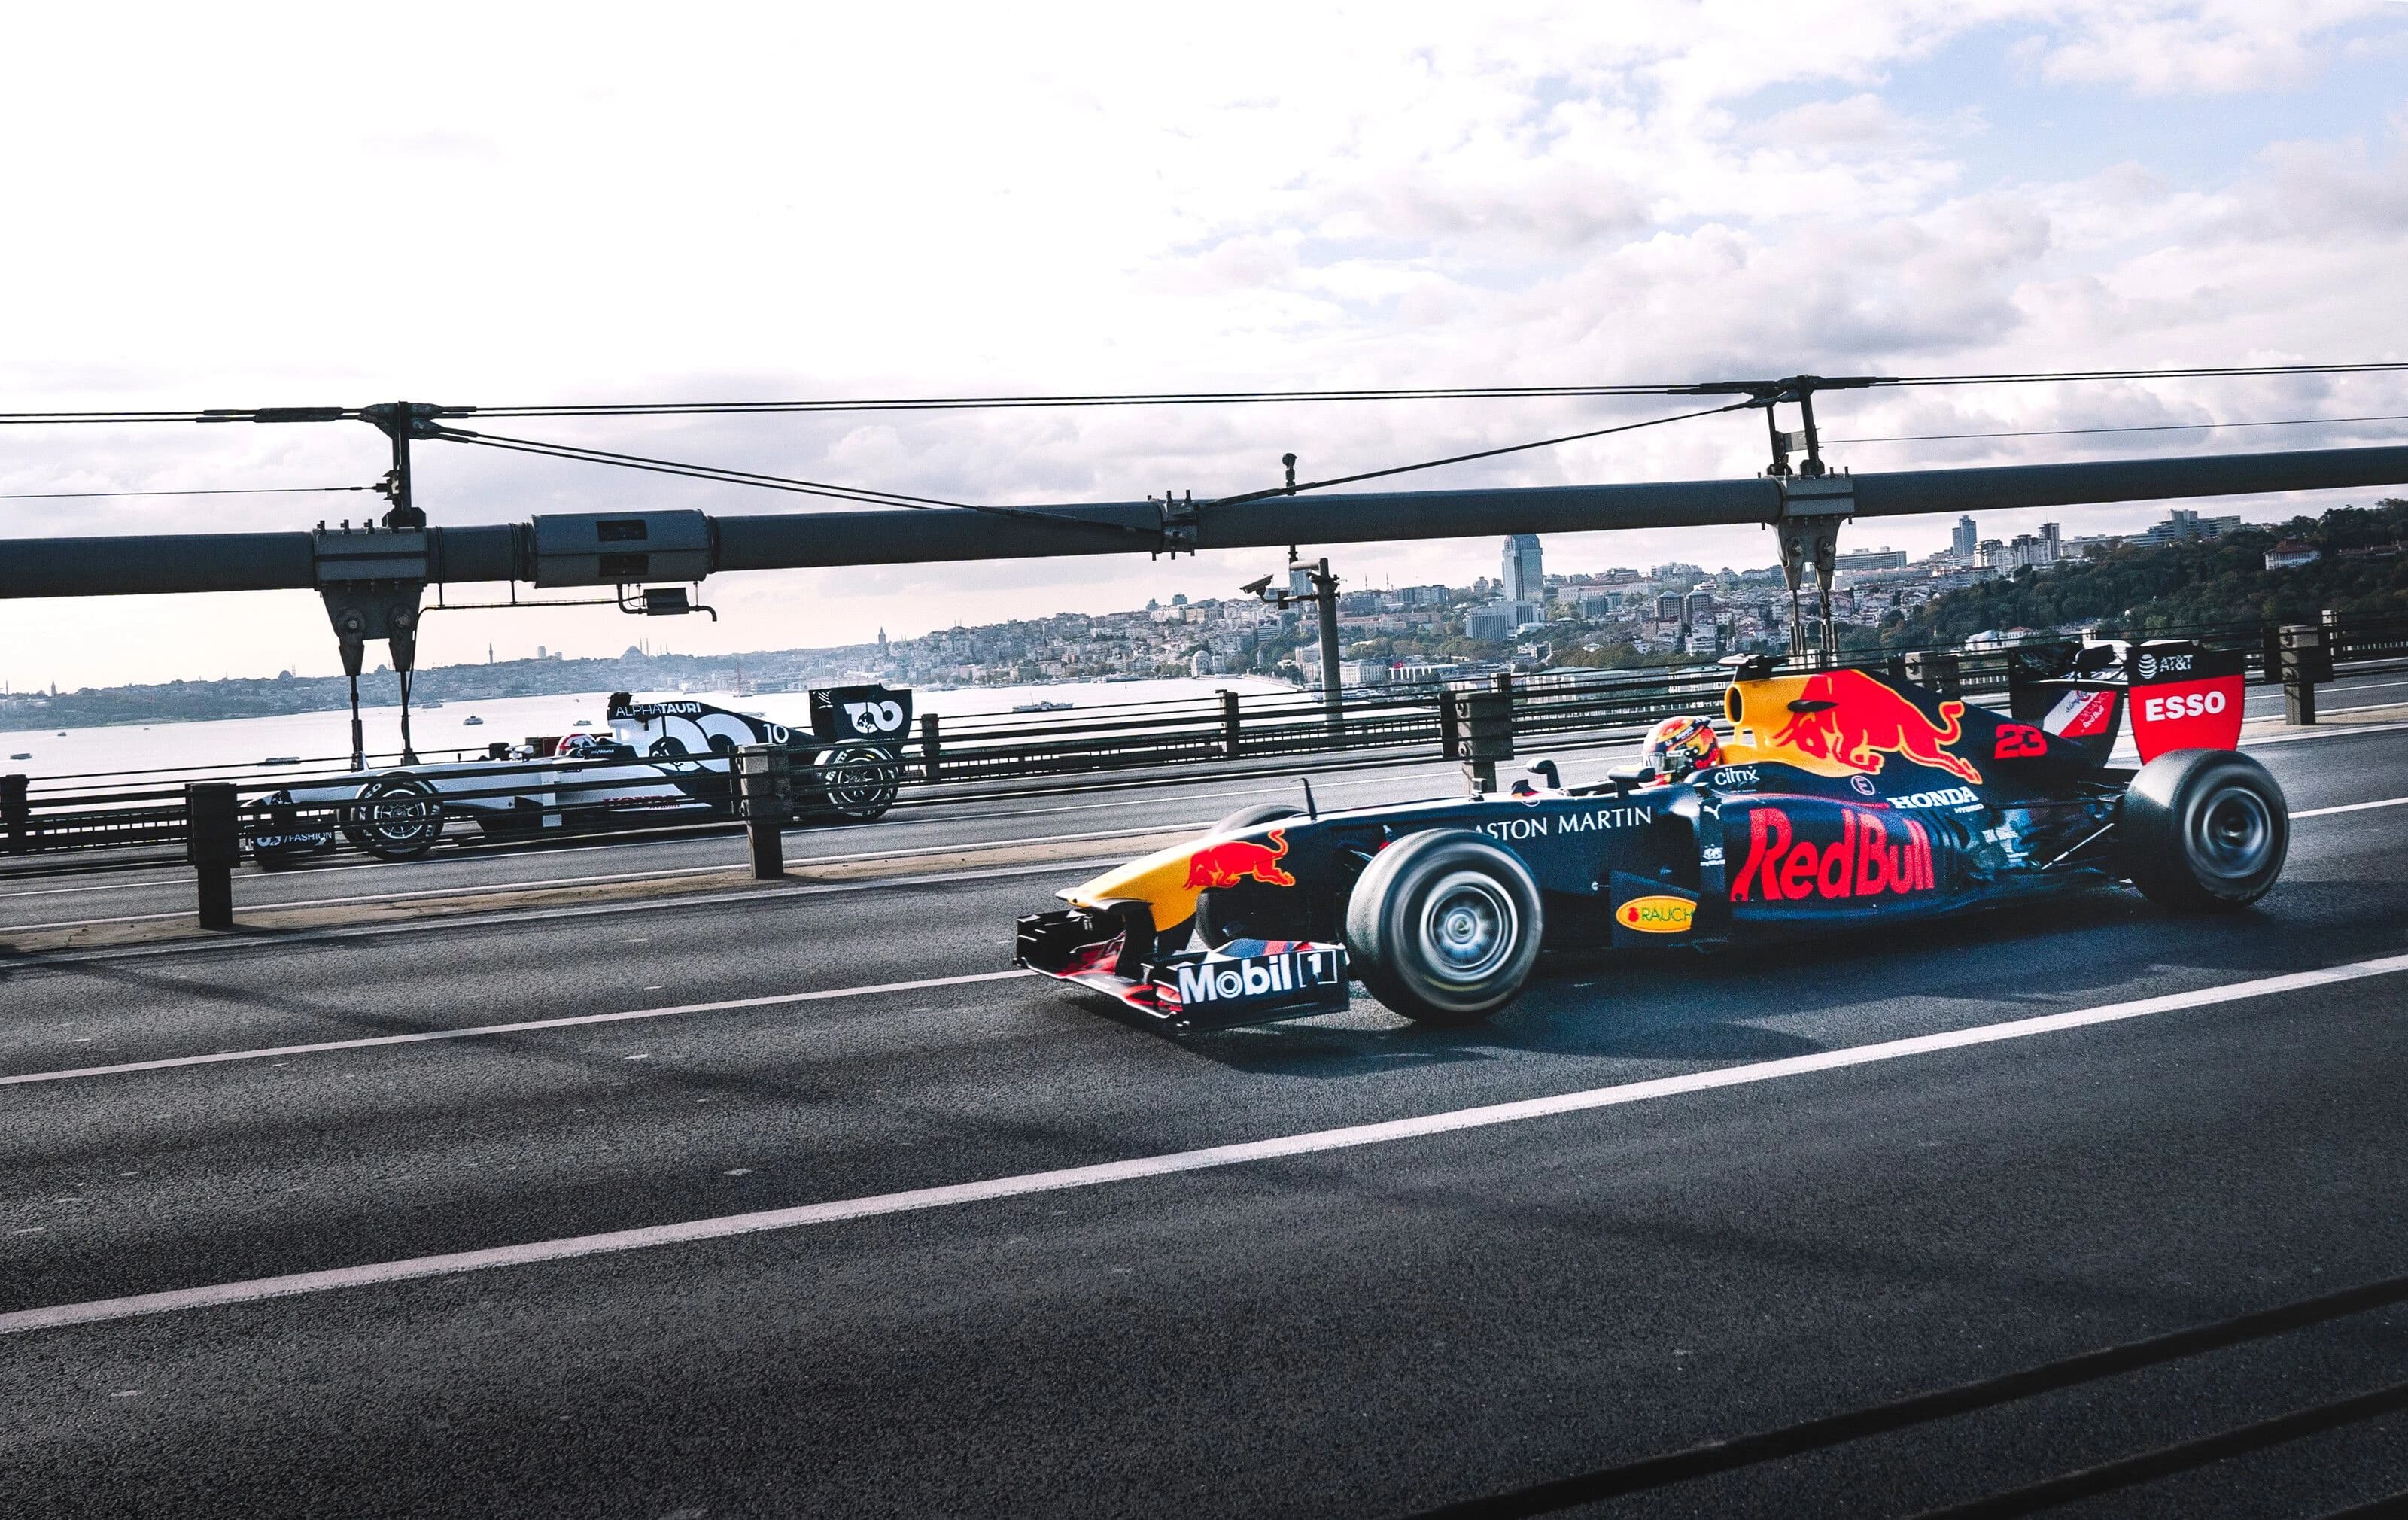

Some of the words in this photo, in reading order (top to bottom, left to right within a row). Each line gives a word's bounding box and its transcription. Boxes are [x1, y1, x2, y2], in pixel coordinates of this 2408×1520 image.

[2160, 655, 2193, 672] AT&T
[616, 701, 701, 717] ALPHATAURI
[2145, 690, 2226, 722] ESSO
[763, 724, 789, 744] 10
[1994, 724, 2047, 759] 23
[1886, 786, 1979, 809] HONDA
[1558, 805, 1652, 834] MARTIN
[1641, 907, 1695, 921] RAUCH
[1178, 953, 1292, 1005] Mobil
